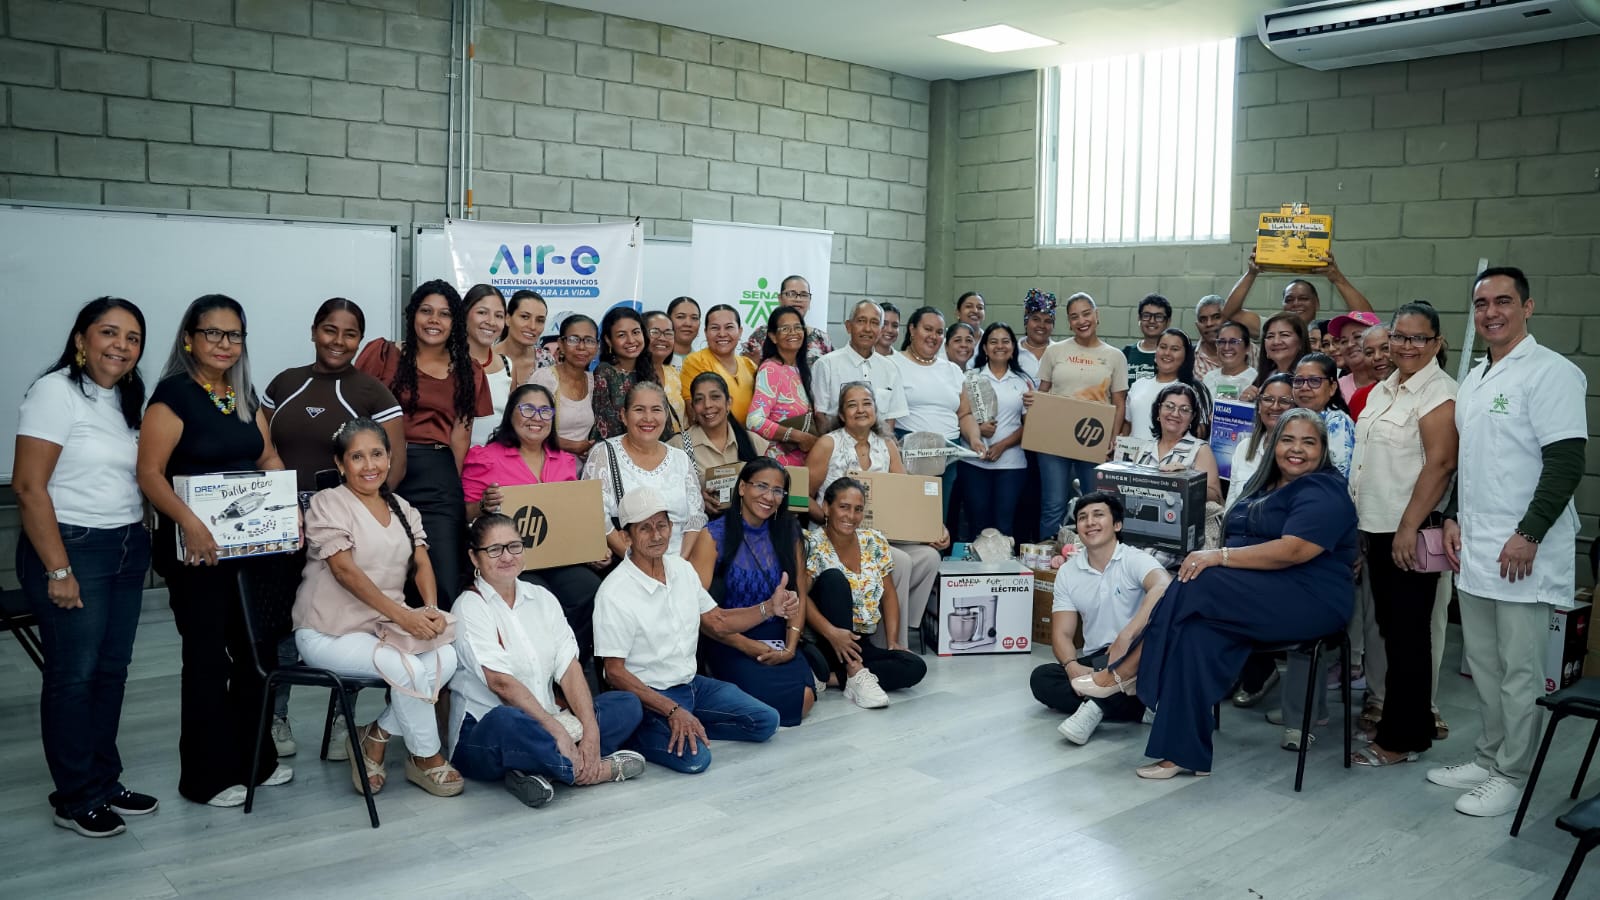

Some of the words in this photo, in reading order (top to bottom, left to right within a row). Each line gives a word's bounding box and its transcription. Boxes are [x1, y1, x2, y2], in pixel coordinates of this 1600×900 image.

[559, 288, 569, 296] LA
[571, 287, 591, 296] VIDA
[742, 290, 779, 299] SENA
[1077, 417, 1102, 448] hp
[991, 585, 1029, 593] ELÉCTRICA
